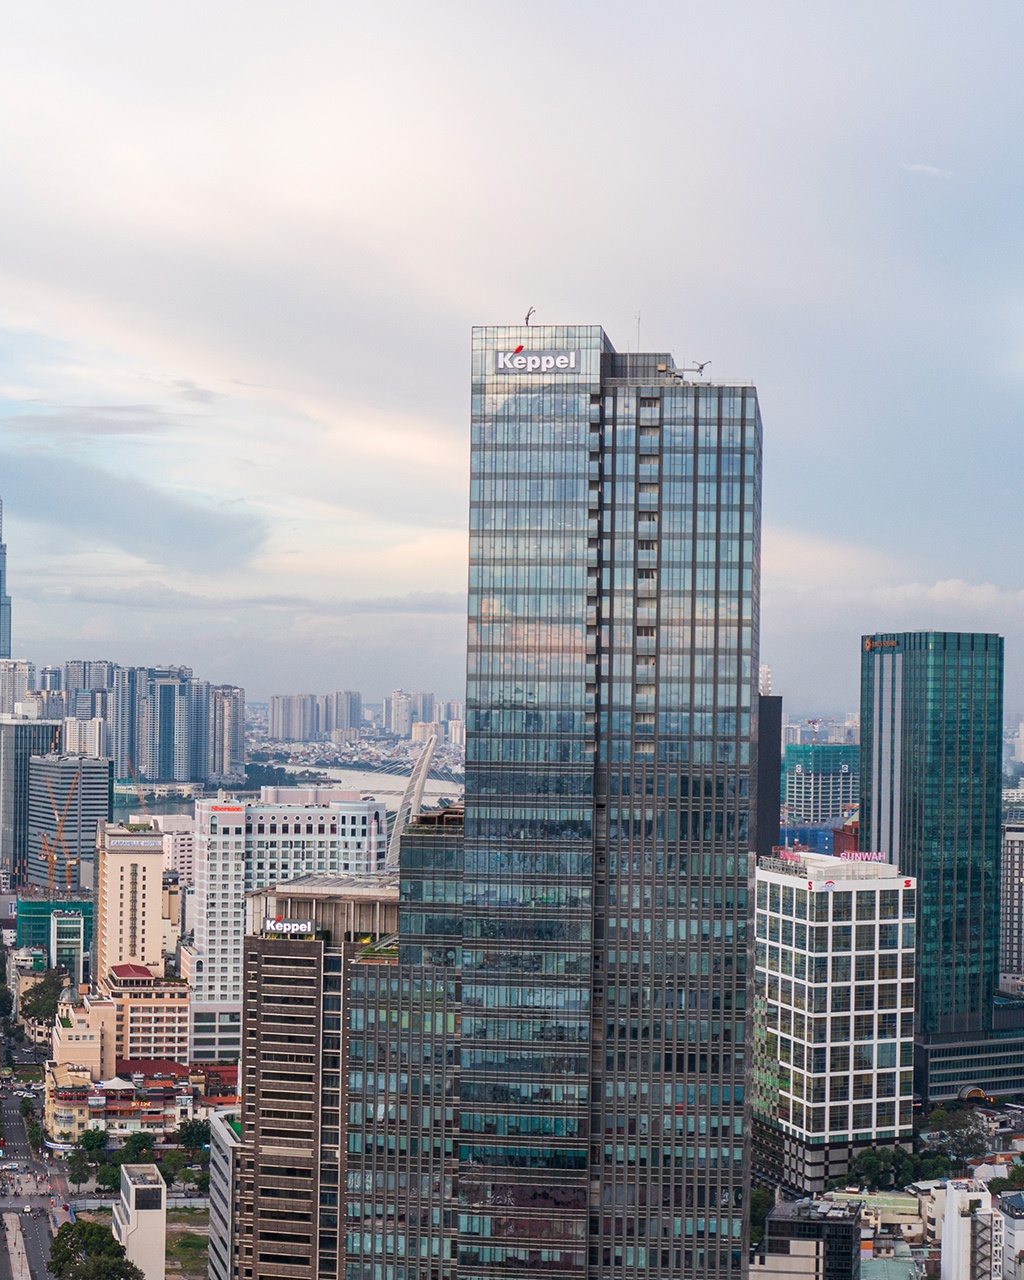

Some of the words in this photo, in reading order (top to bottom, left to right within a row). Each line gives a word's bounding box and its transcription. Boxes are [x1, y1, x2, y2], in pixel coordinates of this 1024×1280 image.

[498, 346, 575, 372] Keppel
[840, 852, 886, 862] SUNWAH
[266, 916, 311, 933] Keppel
